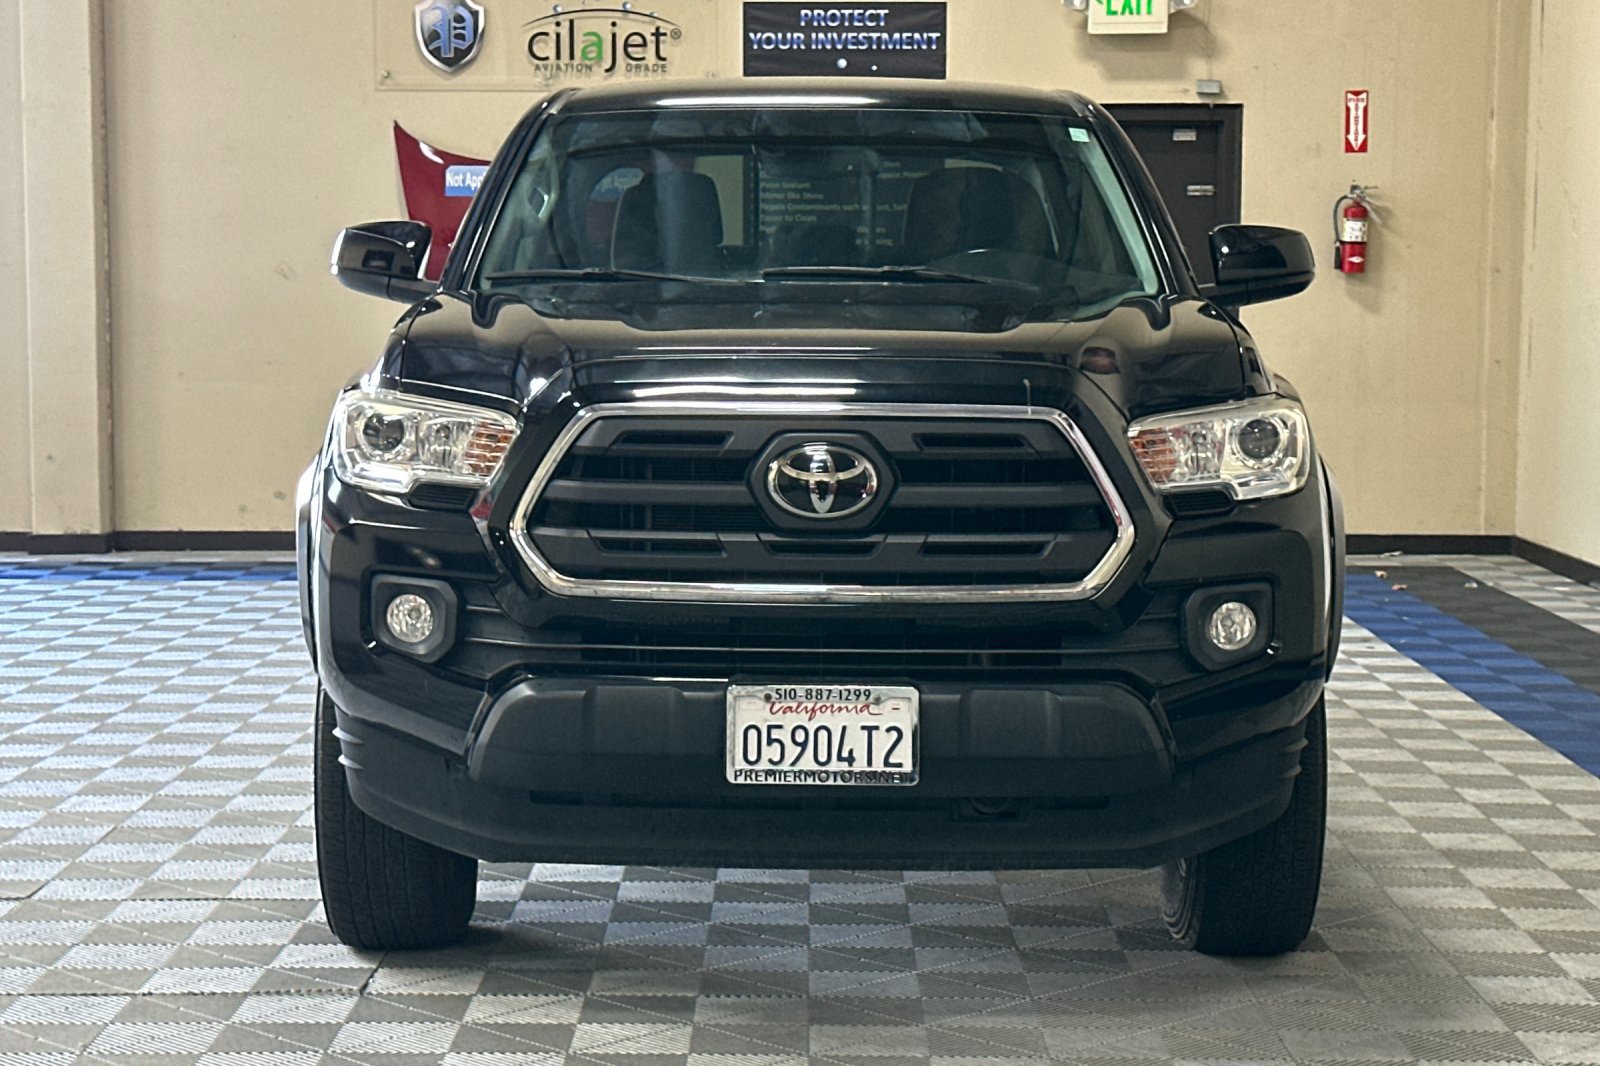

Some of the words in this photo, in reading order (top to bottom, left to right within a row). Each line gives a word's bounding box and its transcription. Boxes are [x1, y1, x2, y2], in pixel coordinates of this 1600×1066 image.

[800, 9, 890, 27] PROTECT
[749, 32, 806, 50] YOUR
[811, 32, 941, 50] INVESTMENT
[534, 63, 593, 73] AVIATION
[446, 171, 463, 187] Not
[774, 688, 872, 701] 510-887-1299
[769, 701, 883, 721] California
[742, 724, 904, 768] 05904T2
